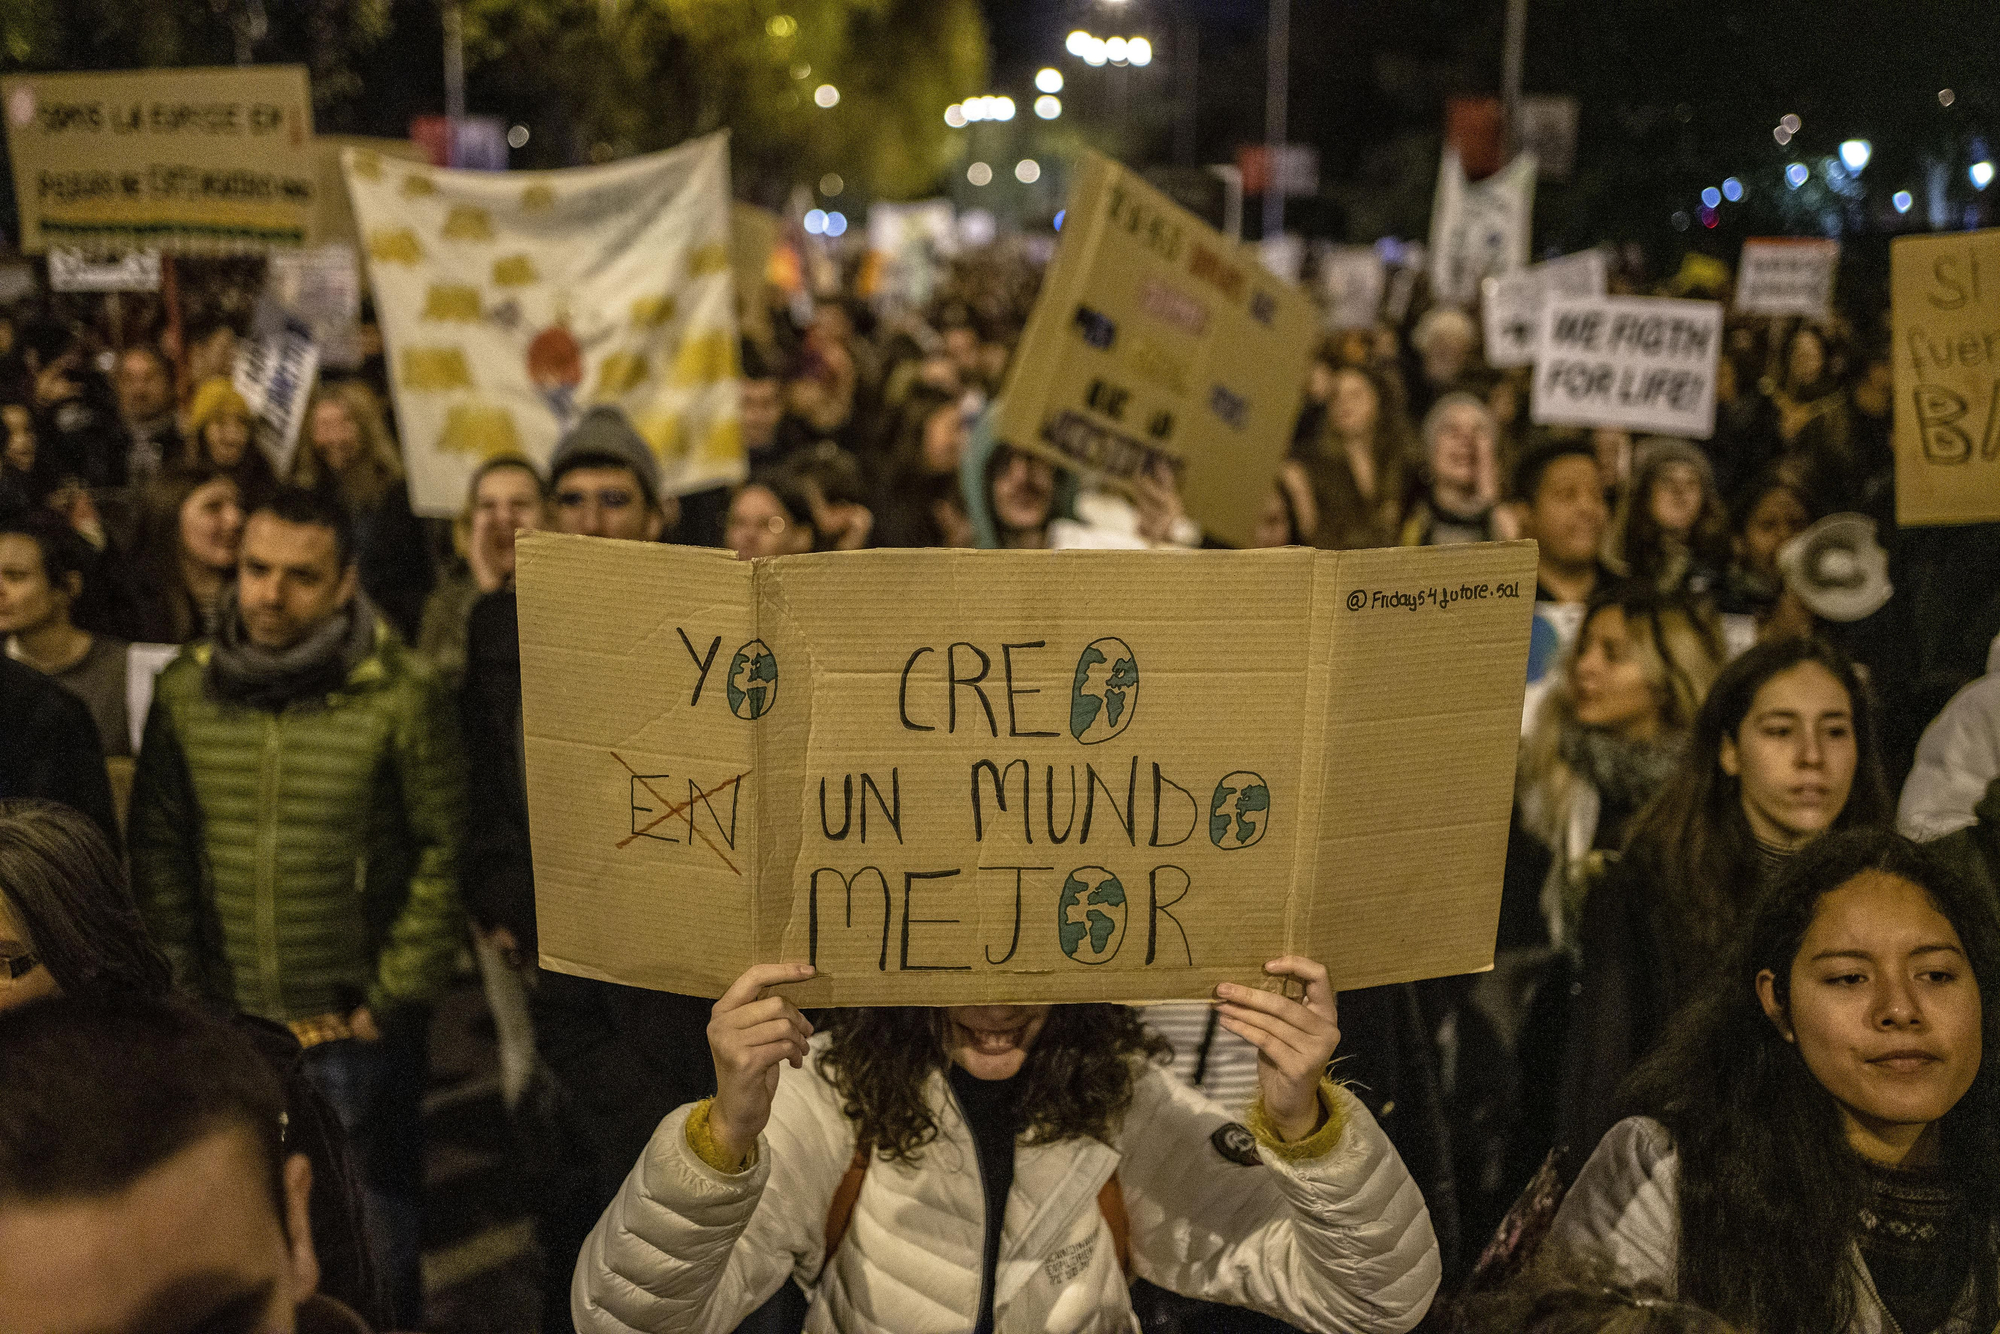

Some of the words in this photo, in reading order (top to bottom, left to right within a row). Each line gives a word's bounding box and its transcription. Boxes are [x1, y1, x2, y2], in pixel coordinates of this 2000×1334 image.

[1554, 309, 1605, 351] WE
[1547, 361, 1612, 401] FOR
[676, 626, 779, 720] YO
[899, 636, 1140, 745] CREO
[819, 767, 903, 845] UN
[970, 755, 1271, 850] MUNDO
[810, 864, 1192, 972] MEJOR
